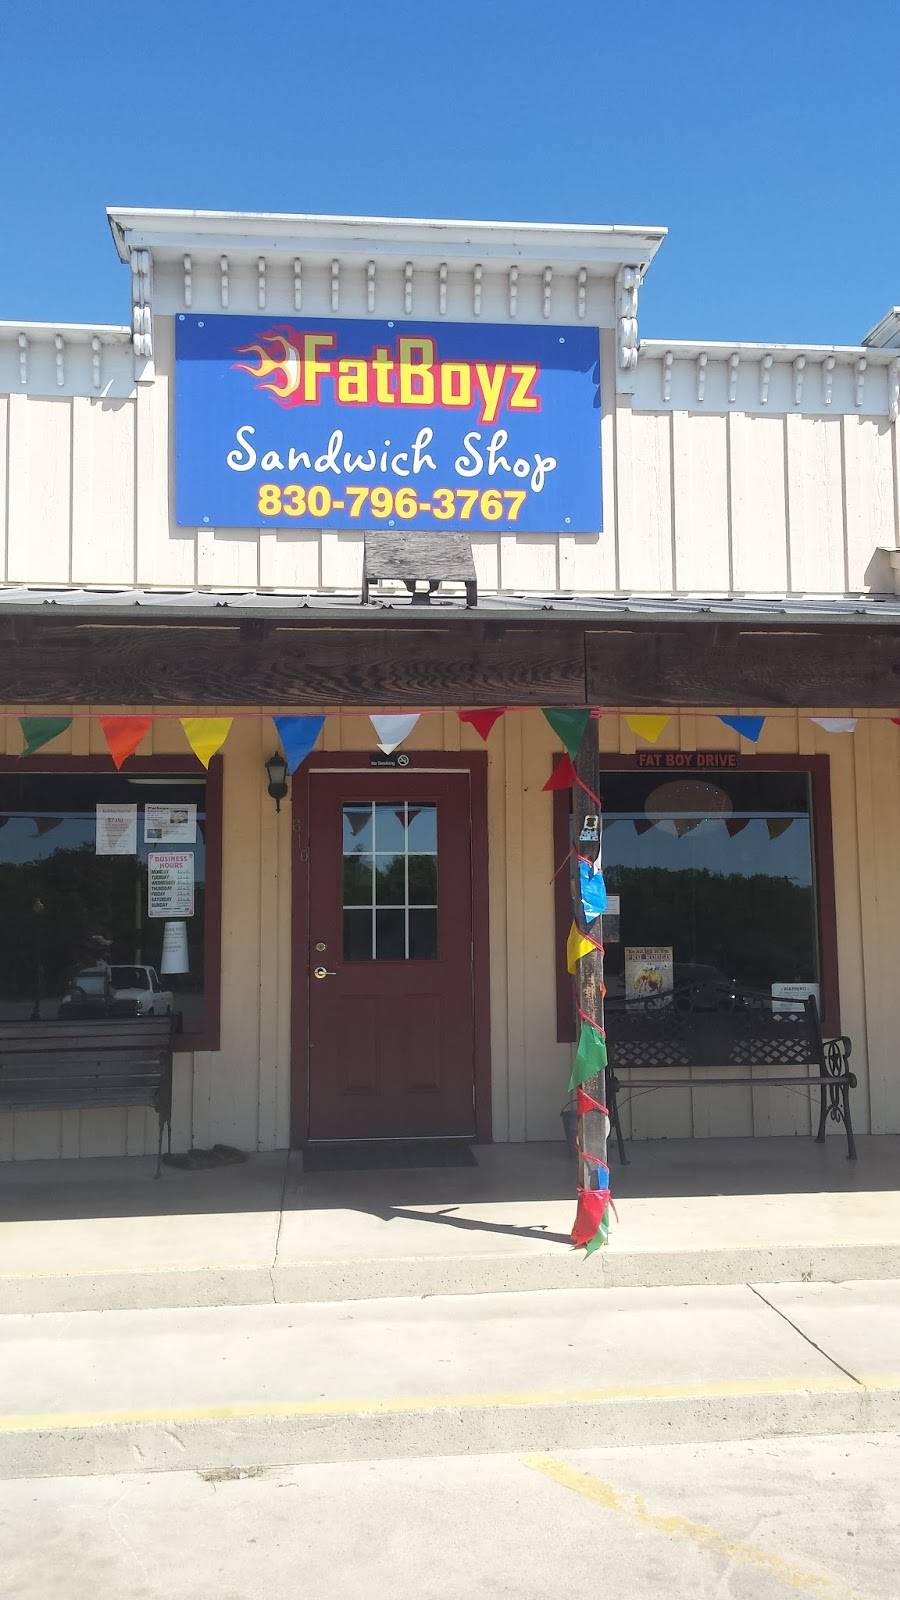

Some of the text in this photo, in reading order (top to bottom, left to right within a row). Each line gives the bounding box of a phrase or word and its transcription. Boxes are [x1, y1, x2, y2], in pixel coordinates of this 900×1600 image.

[302, 333, 540, 424] FatBoyz
[226, 425, 557, 492] Sandwich Shop
[257, 484, 527, 520] 830-796-3767
[639, 754, 737, 767] FAT BOY DRIVE
